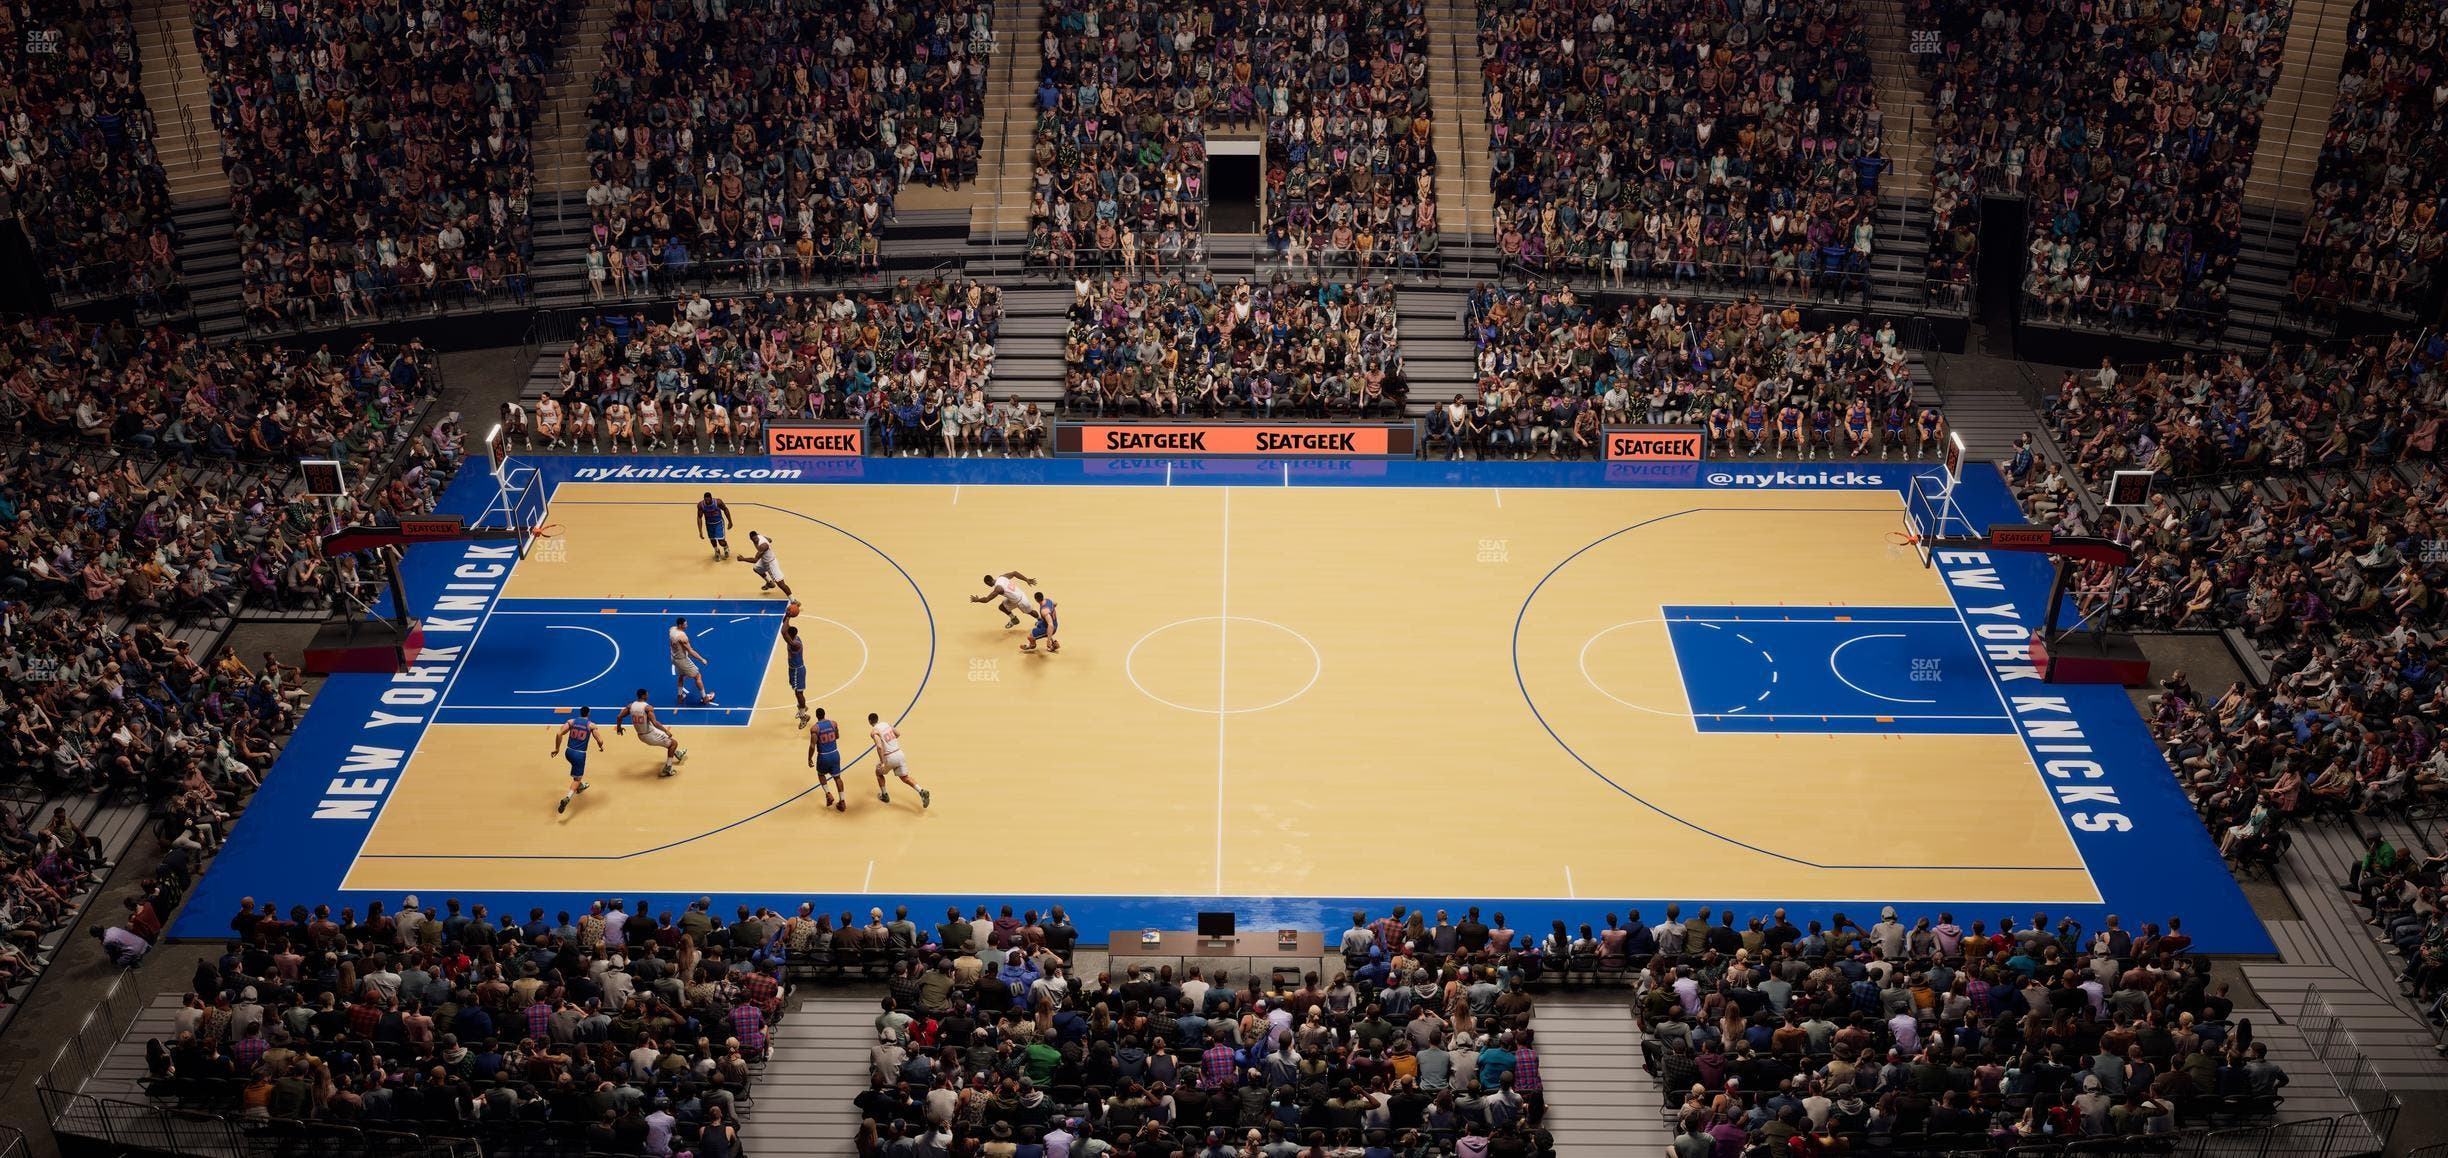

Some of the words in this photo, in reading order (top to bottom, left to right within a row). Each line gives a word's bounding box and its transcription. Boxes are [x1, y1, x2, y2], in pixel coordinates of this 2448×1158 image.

[775, 433, 856, 452] SEATGEEK
[1107, 431, 1206, 450] SEATGEEK
[1256, 432, 1355, 451] SEATGEEK
[1614, 438, 1695, 457] SEATGEEK
[574, 464, 802, 482] nyknicks.com
[1707, 471, 1883, 488] @nyknicks
[407, 524, 454, 534] SEATGEEK
[1999, 533, 2044, 542] SEATGEEK
[1937, 551, 2005, 591] EW
[1965, 603, 2044, 682] YORK
[311, 744, 405, 819] NEW
[363, 645, 463, 729] YORK
[421, 544, 518, 631] KNICK
[2010, 696, 2133, 832] KNICKS
[1010, 980, 1025, 997] 00
